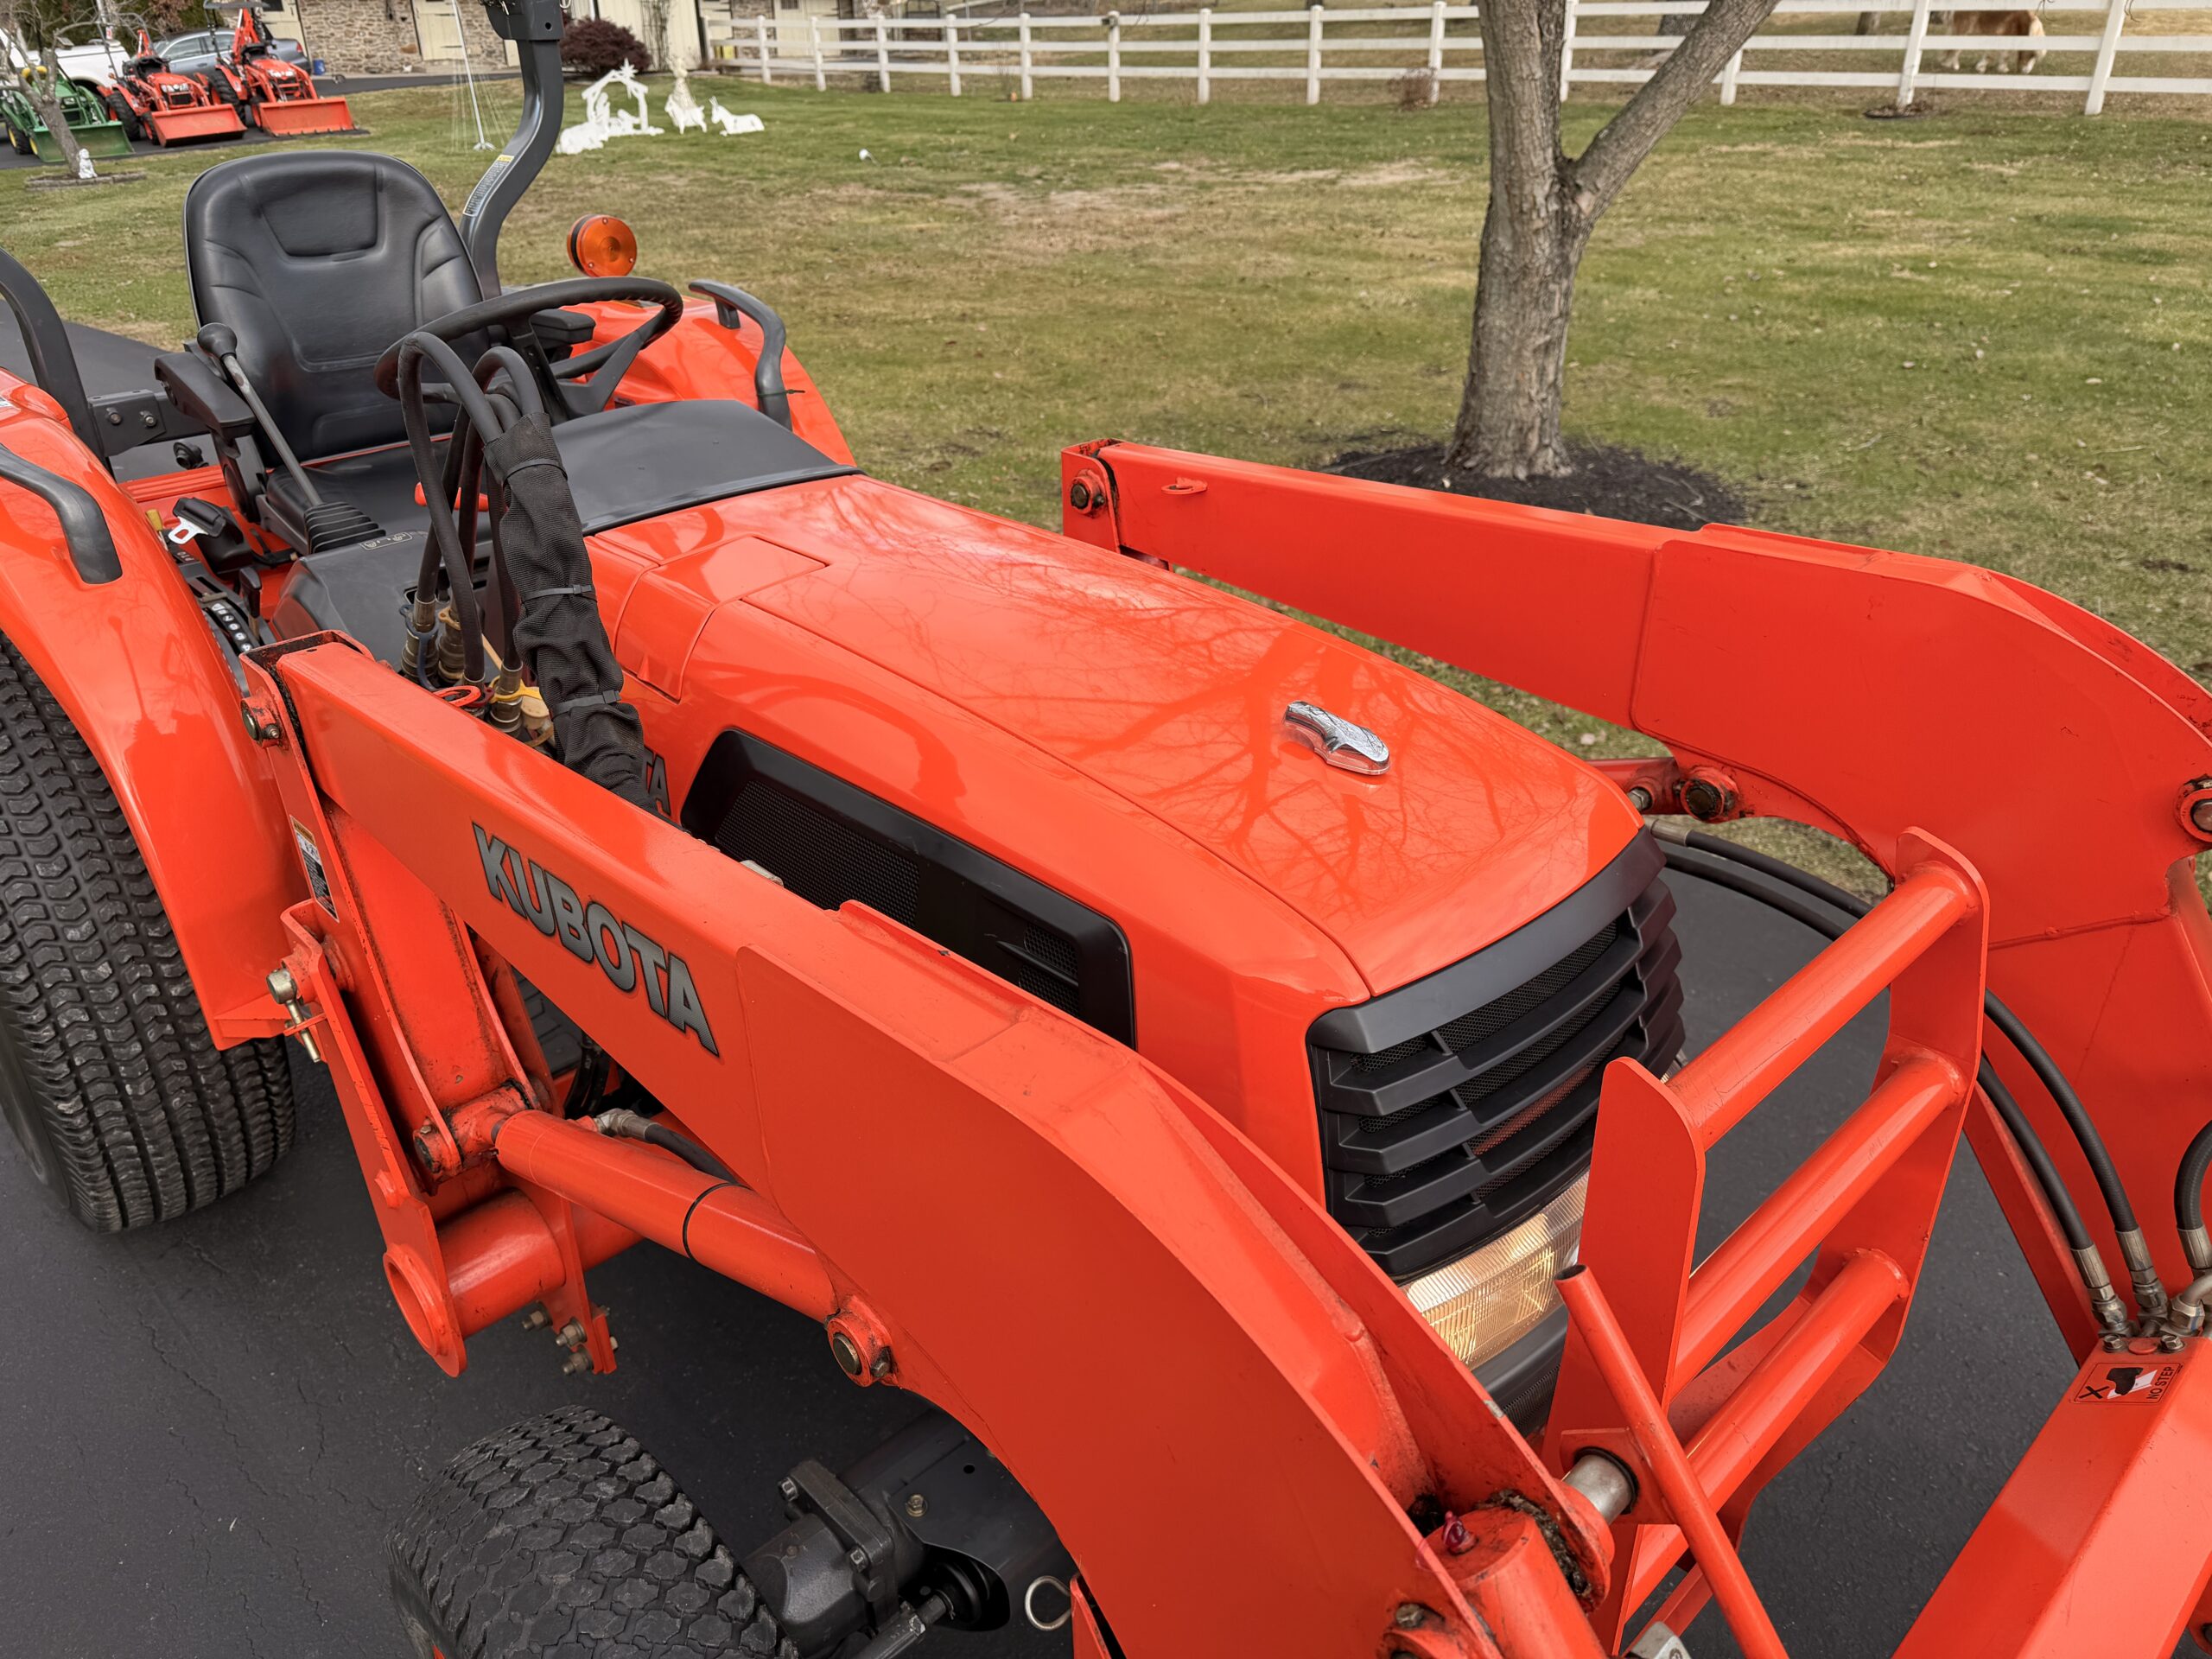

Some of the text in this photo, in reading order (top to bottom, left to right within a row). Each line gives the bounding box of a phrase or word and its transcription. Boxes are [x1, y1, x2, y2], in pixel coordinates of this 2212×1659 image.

[472, 821, 720, 1058] KUBOTA
[2146, 1366, 2175, 1399] NO STEP
